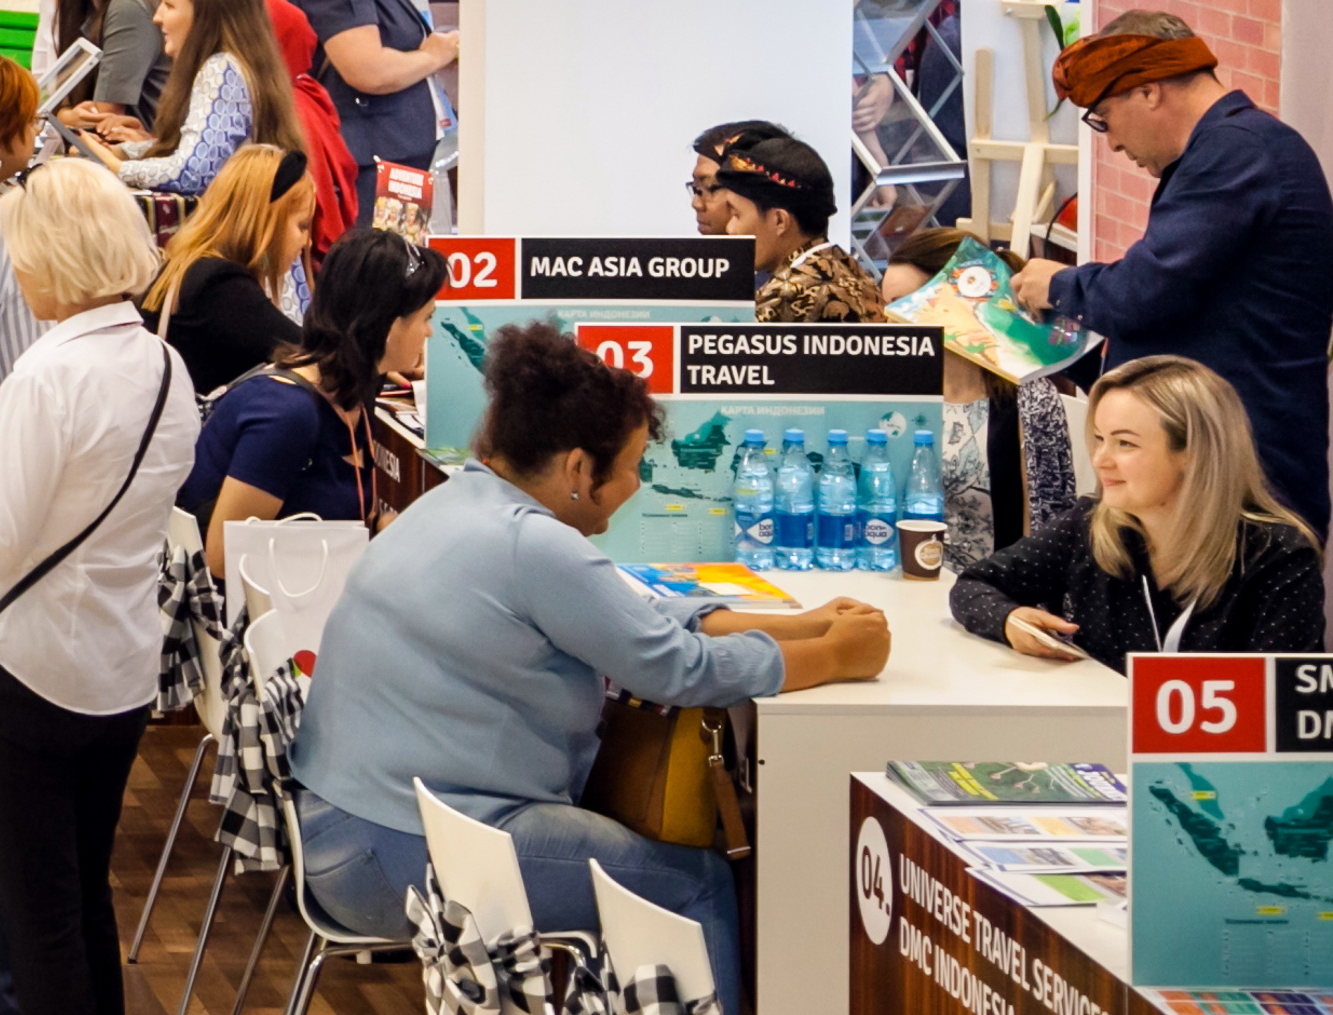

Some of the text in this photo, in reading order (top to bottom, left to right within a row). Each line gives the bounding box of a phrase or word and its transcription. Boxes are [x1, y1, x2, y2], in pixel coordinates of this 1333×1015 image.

[447, 251, 731, 289] 02 MAC ASIA GROUP
[596, 334, 936, 380] 03 PEGASUS INDONESIA
[686, 365, 775, 385] TRAVEL
[1155, 678, 1238, 735] 05
[899, 852, 971, 945] UNIVERSE
[973, 909, 1031, 992] TRAVEL
[899, 915, 932, 976] DMC
